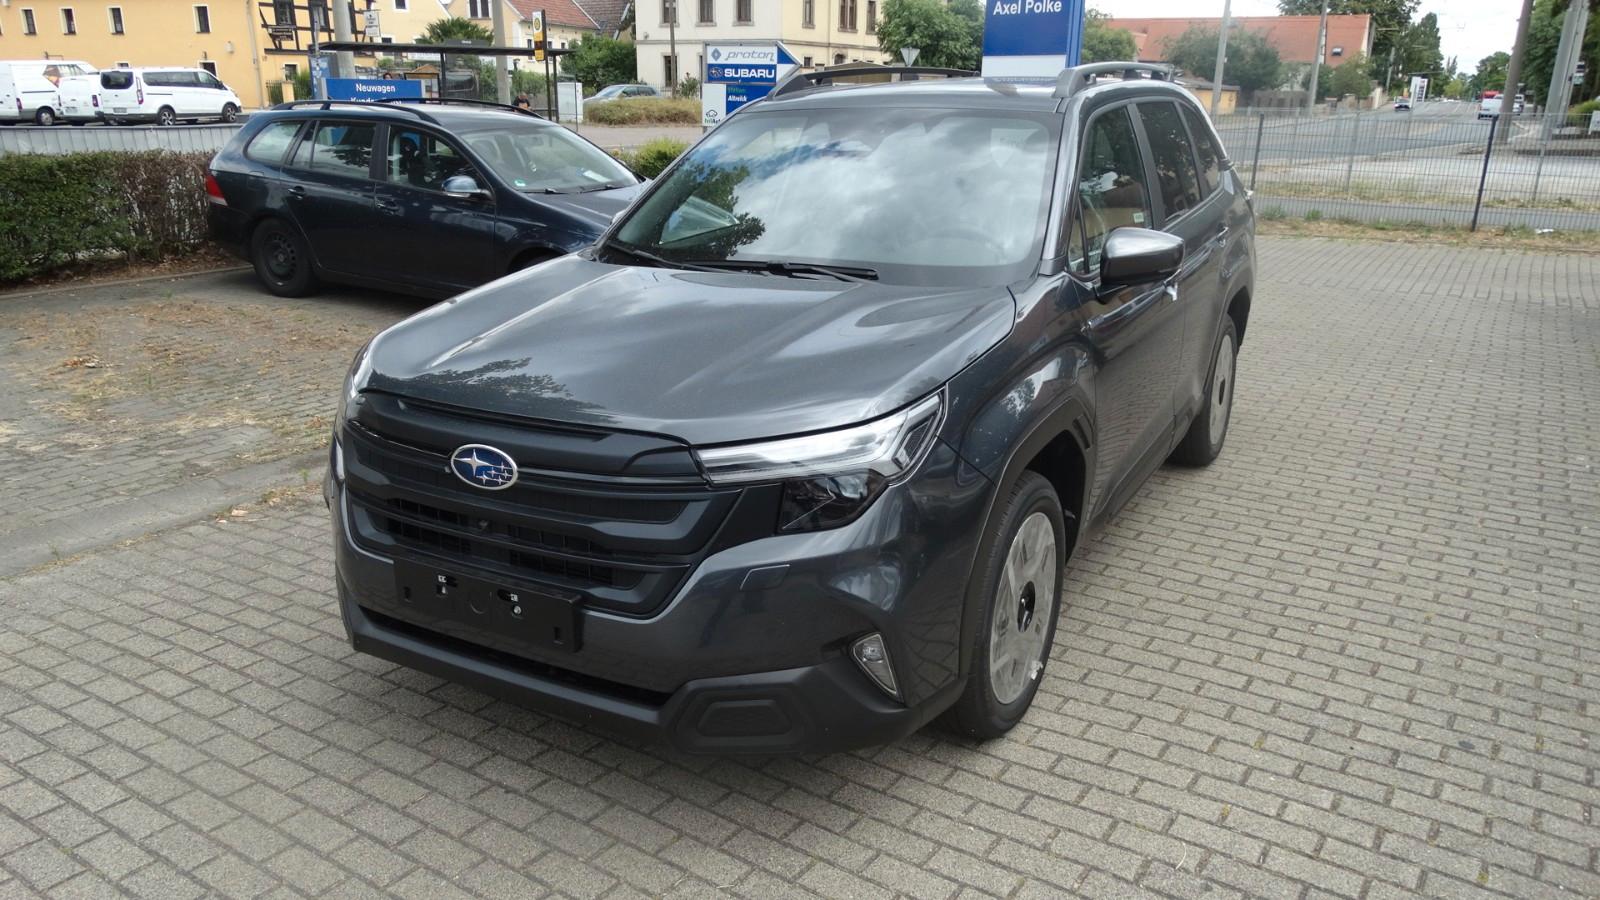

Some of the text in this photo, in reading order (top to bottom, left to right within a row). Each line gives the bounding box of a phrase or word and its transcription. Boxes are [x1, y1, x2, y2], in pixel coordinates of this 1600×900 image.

[993, 0, 1063, 15] Axel Polke
[724, 50, 775, 61] proton
[724, 68, 775, 78] SUBARU
[355, 83, 396, 93] Neuwagen
